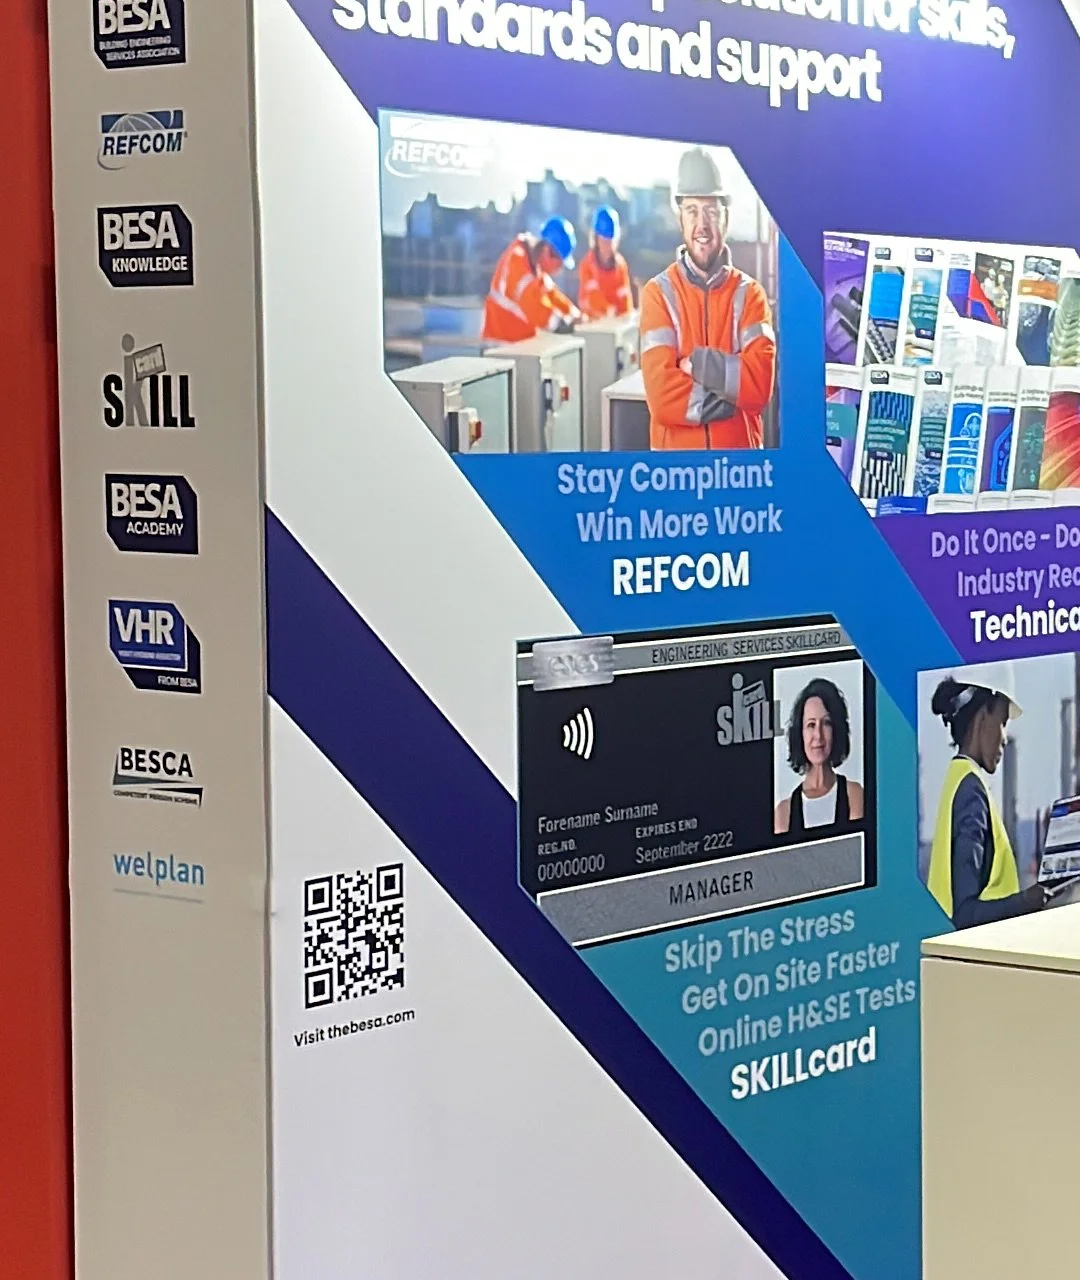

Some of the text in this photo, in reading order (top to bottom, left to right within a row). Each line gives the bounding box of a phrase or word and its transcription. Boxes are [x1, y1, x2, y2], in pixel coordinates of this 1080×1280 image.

[616, 20, 712, 80] and
[716, 36, 882, 112] support
[103, 131, 183, 156] REFCOM
[391, 139, 482, 168] REFCO
[102, 210, 180, 251] BESA
[112, 255, 188, 273] KNOWLEDGE
[558, 457, 773, 503] Stay Compliant
[111, 482, 184, 520] BESA
[126, 521, 184, 536] ACADEMY
[576, 503, 783, 542] Win More Work
[931, 531, 959, 557] Do
[964, 529, 979, 555] It
[983, 528, 1036, 553] Once
[1055, 523, 1080, 549] Do
[613, 551, 749, 596] REFCOM
[958, 567, 1044, 598] Industry
[113, 607, 175, 645] VHR
[652, 631, 841, 664] ENGINEERING SERVICES SKILLCARD
[157, 675, 179, 686] FROM
[120, 747, 193, 778] BESCA
[538, 802, 659, 835] Forename Surname
[635, 818, 698, 839] EXPIRES END
[636, 831, 734, 864] September 2222
[113, 851, 205, 887] welplan
[537, 853, 605, 882] 00000000
[669, 871, 754, 906] MANAGER
[665, 909, 855, 974] Skip The Stress
[682, 941, 900, 1014] Get On Site Faster
[294, 1009, 415, 1046] Visit thebesa.com
[698, 978, 916, 1056] Online H&SE Tests
[731, 1026, 876, 1100] SKILLcard
